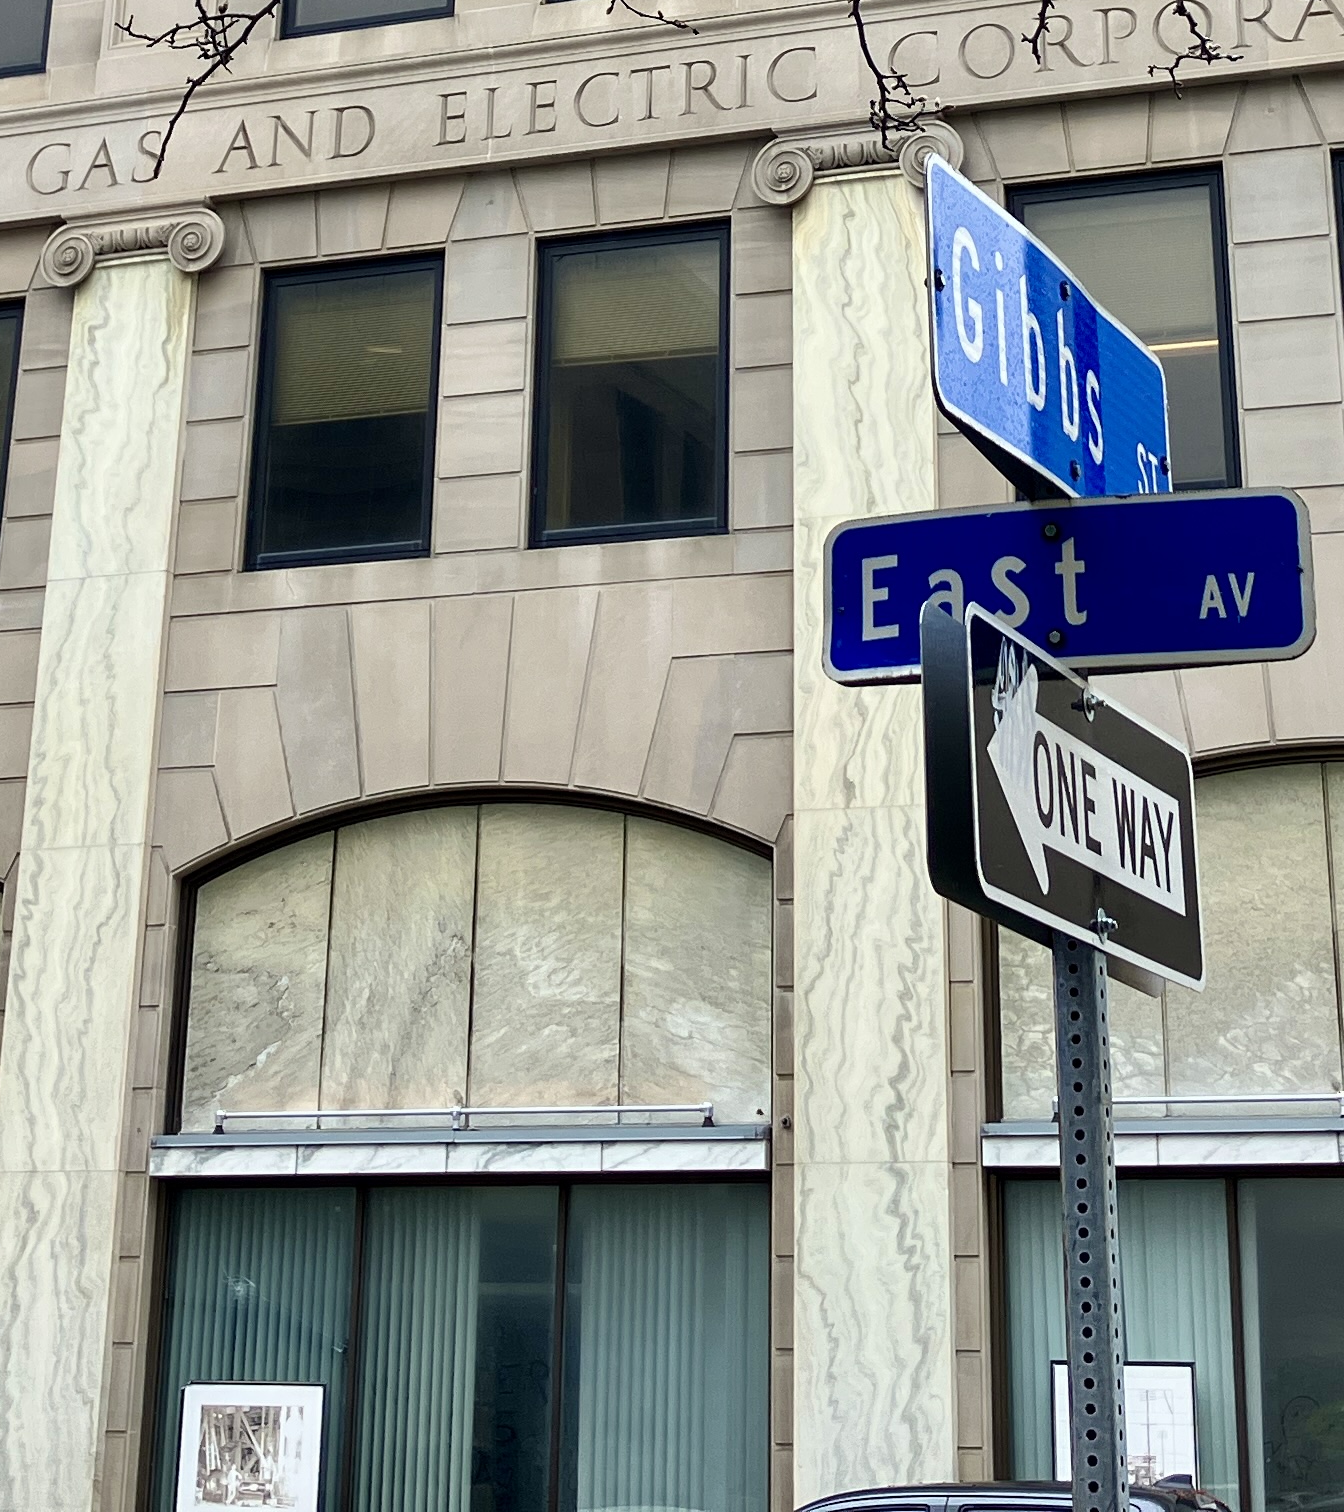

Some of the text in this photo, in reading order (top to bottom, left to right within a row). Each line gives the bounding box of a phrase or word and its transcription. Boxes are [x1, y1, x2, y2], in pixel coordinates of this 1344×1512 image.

[25, 130, 164, 197] GAS
[213, 104, 378, 175] AND
[434, 45, 819, 148] ELECTRIC
[950, 225, 1160, 494] Gibbs ST
[861, 536, 1256, 642] East AV
[1031, 730, 1178, 895] ONE WAY
